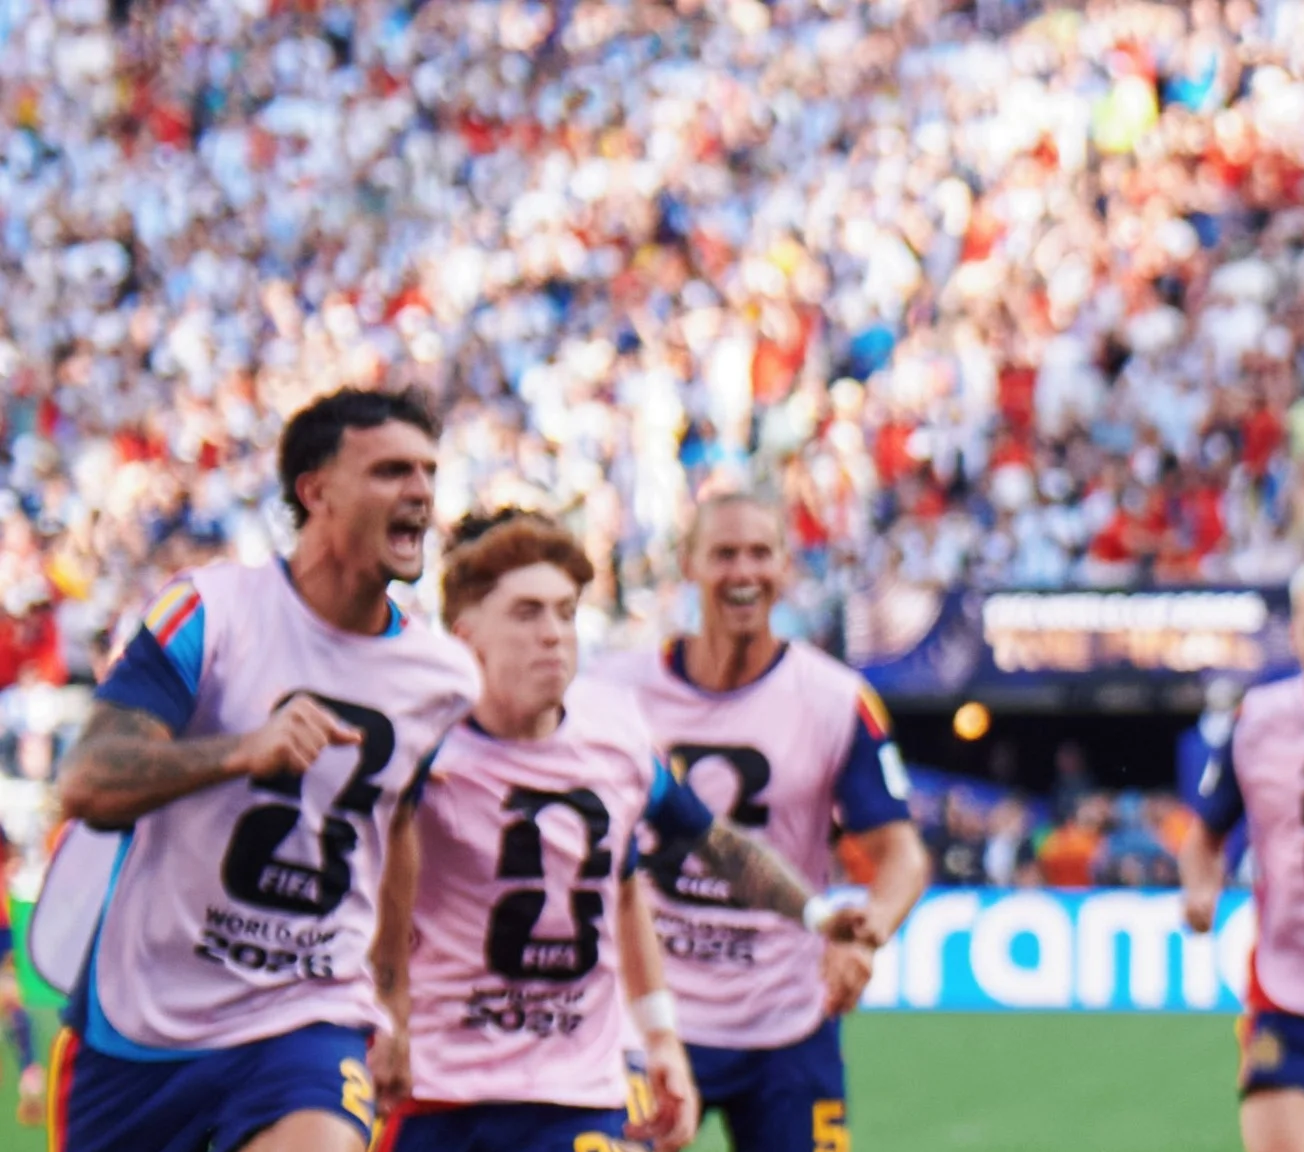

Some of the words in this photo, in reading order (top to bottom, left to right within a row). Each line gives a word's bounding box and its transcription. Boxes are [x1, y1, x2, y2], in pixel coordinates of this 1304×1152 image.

[257, 864, 320, 904] FIFA
[206, 905, 291, 941] WORLD
[521, 942, 576, 972] FIFA
